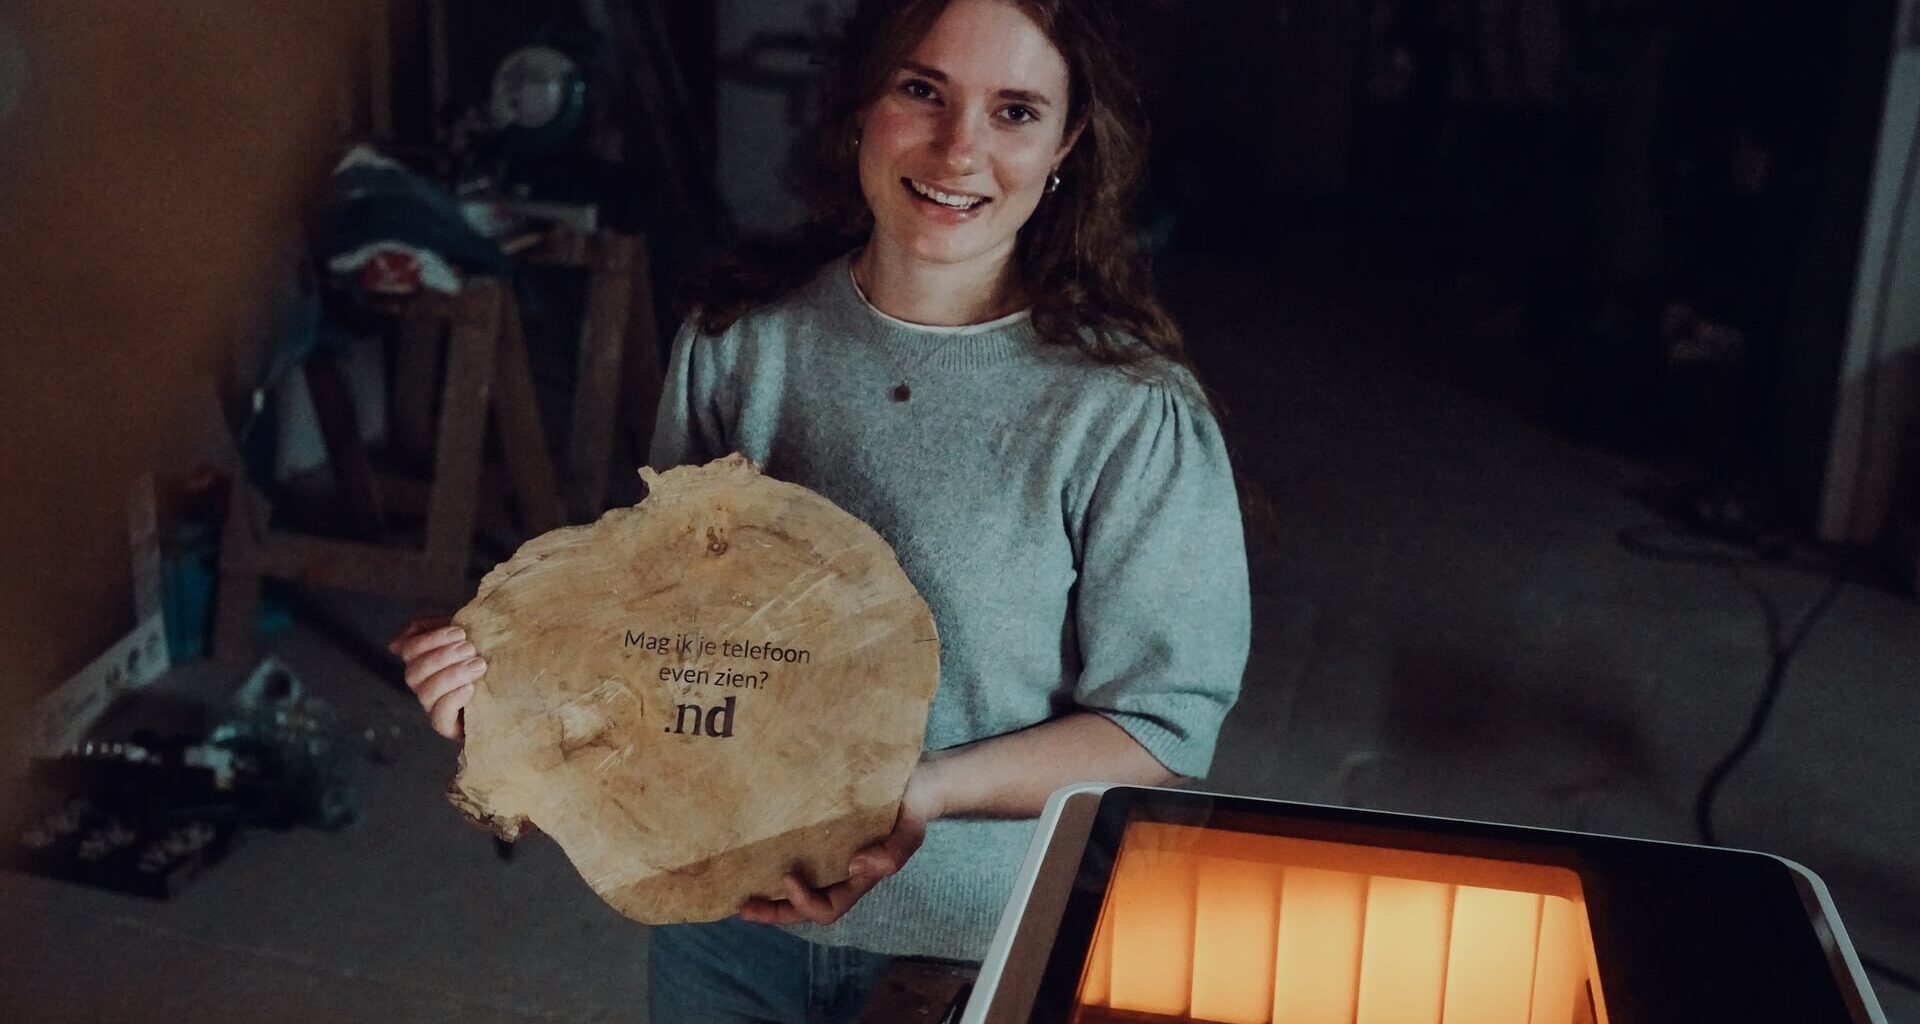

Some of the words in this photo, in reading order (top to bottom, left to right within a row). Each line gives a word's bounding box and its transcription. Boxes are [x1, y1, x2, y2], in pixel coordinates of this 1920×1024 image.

[624, 629, 671, 656] Mag
[676, 633, 693, 654] ik
[697, 636, 717, 659] je
[722, 639, 811, 664] telefoon
[659, 666, 709, 685] even
[714, 668, 769, 690] zien?
[664, 695, 737, 738] .nd
